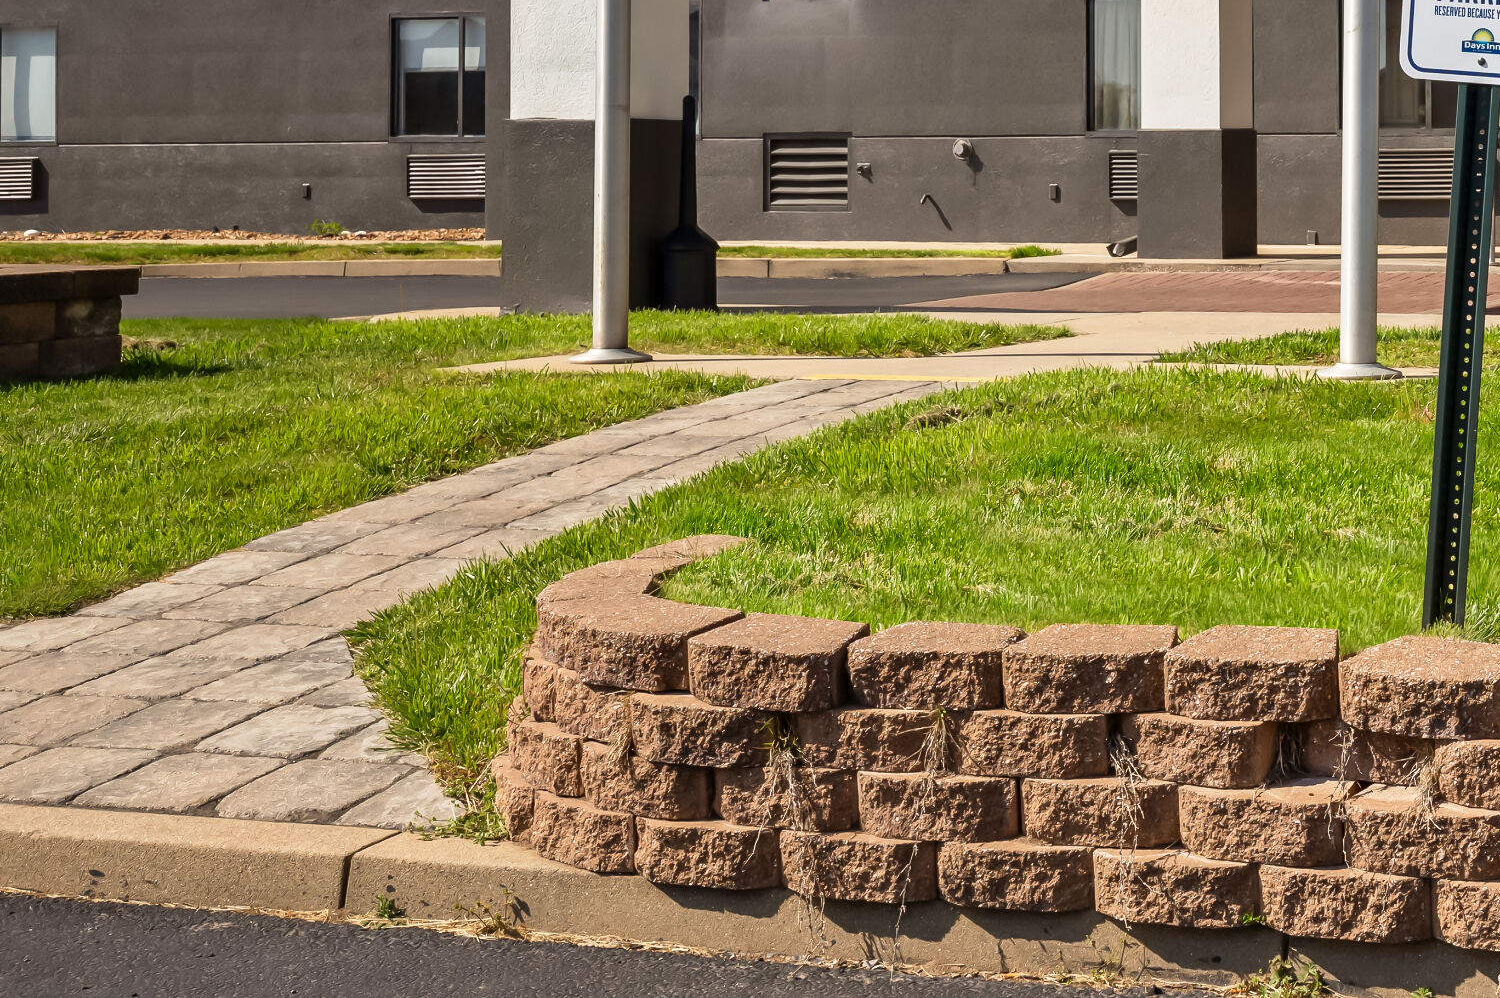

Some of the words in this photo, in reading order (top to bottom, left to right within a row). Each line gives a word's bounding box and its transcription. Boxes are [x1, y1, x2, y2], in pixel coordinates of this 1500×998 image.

[1434, 5, 1466, 17] RESERVED
[1467, 7, 1495, 20] BECAUSE
[1464, 41, 1486, 50] Days
[1486, 42, 1500, 51] Inn
